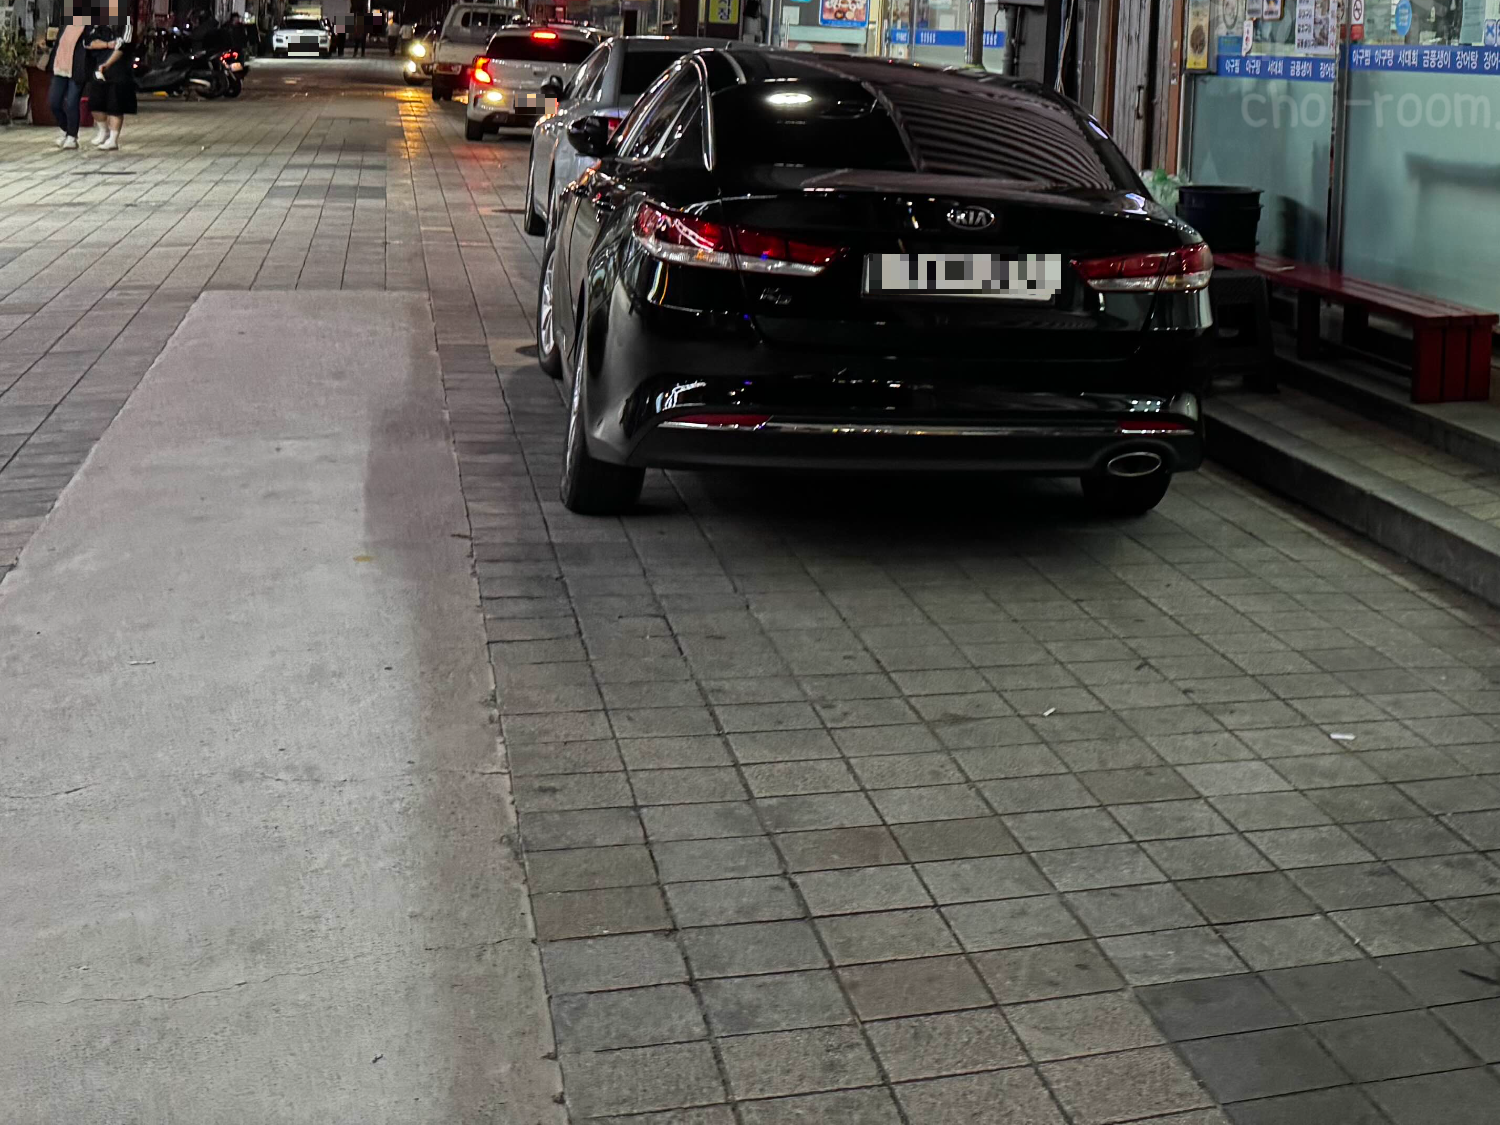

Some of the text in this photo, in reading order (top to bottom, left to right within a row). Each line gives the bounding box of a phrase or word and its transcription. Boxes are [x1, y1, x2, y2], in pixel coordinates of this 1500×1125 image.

[1352, 49, 1371, 66] 아구찜
[1374, 49, 1394, 67] 아구탕
[1397, 49, 1418, 67] 서대회
[1422, 50, 1451, 69] 금풍생이
[1455, 51, 1478, 70] 장어탕
[952, 209, 988, 227] KIA
